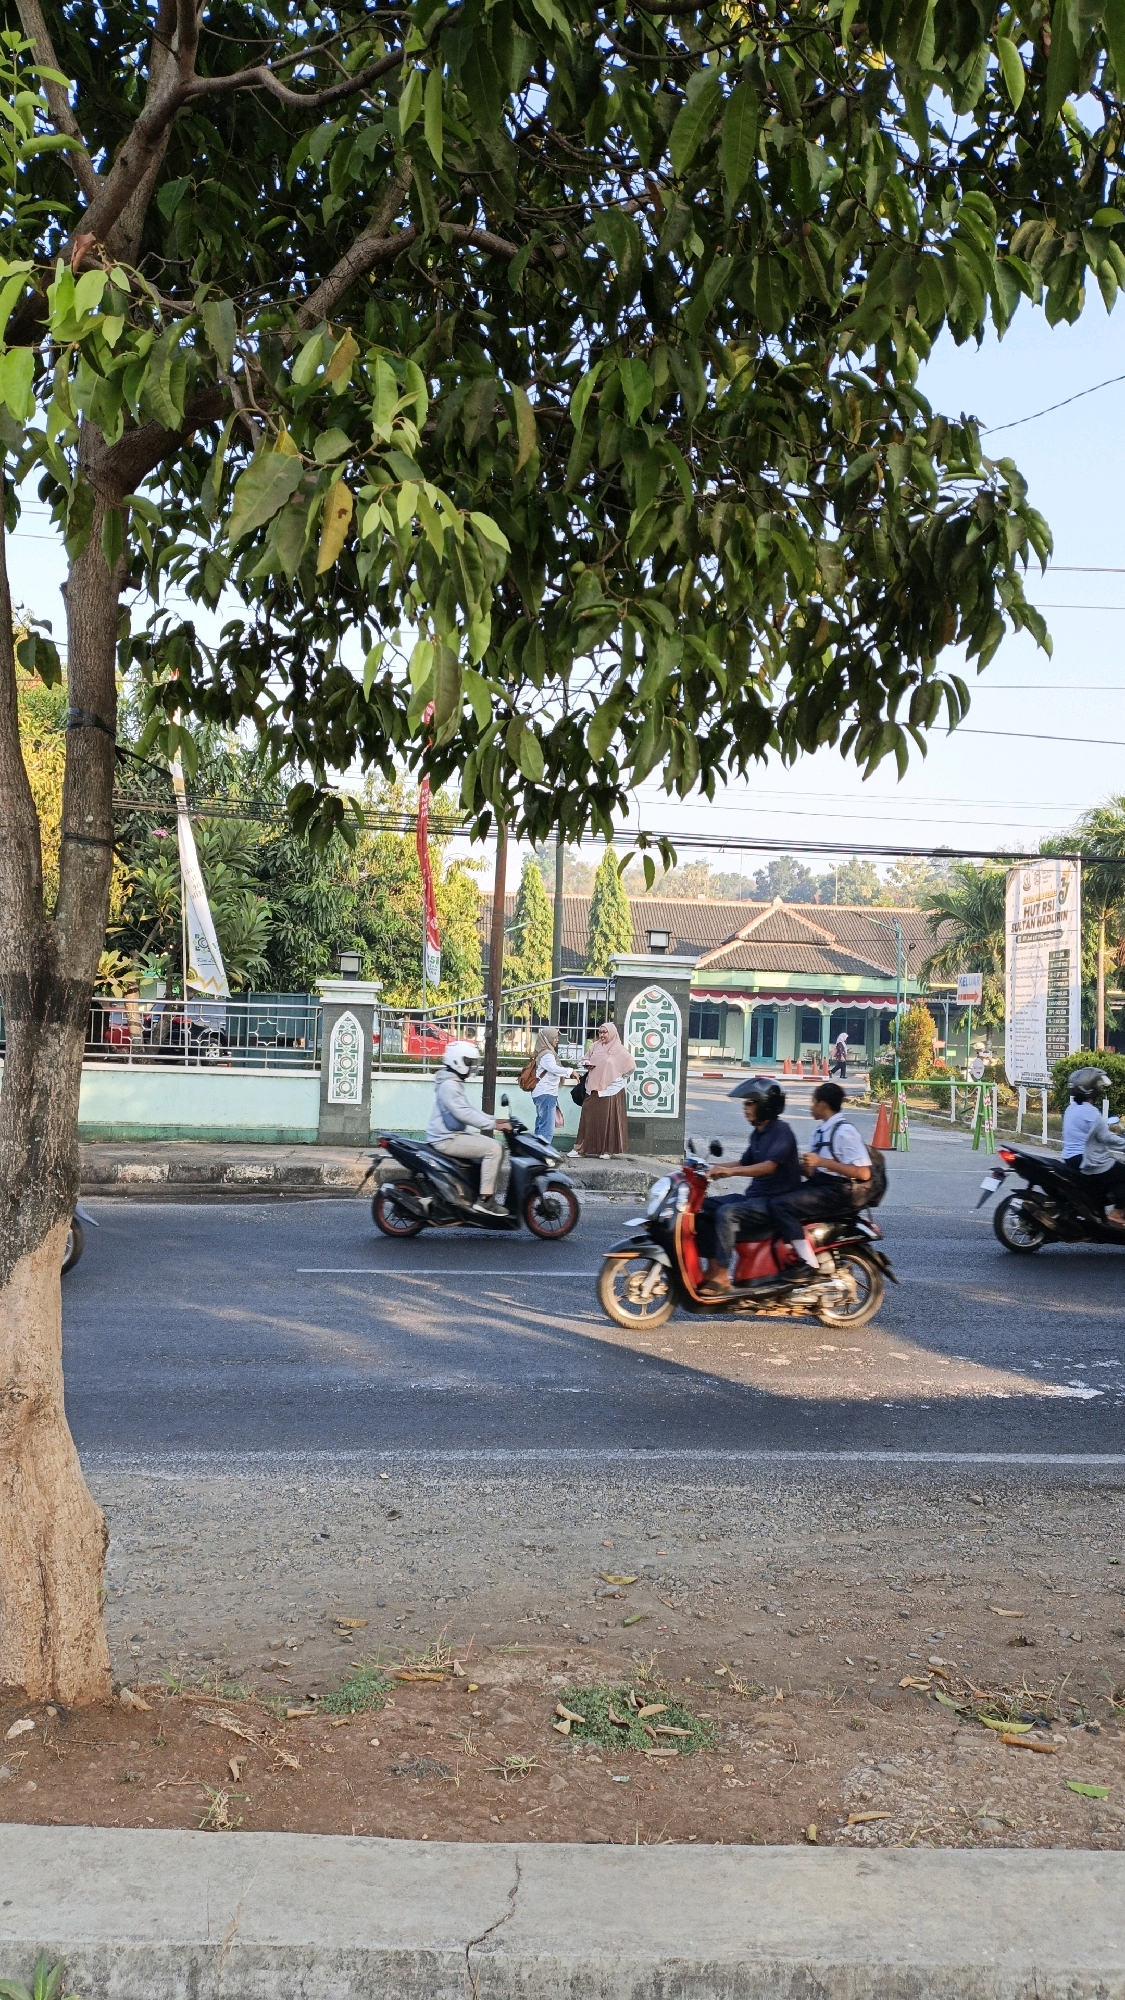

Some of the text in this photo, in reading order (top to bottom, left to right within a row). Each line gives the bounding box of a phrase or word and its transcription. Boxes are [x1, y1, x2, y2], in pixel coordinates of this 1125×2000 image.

[1023, 899, 1055, 919] HUT RSI
[1010, 909, 1069, 933] SULTAN HADLIRIN
[959, 975, 980, 988] KELUAR
